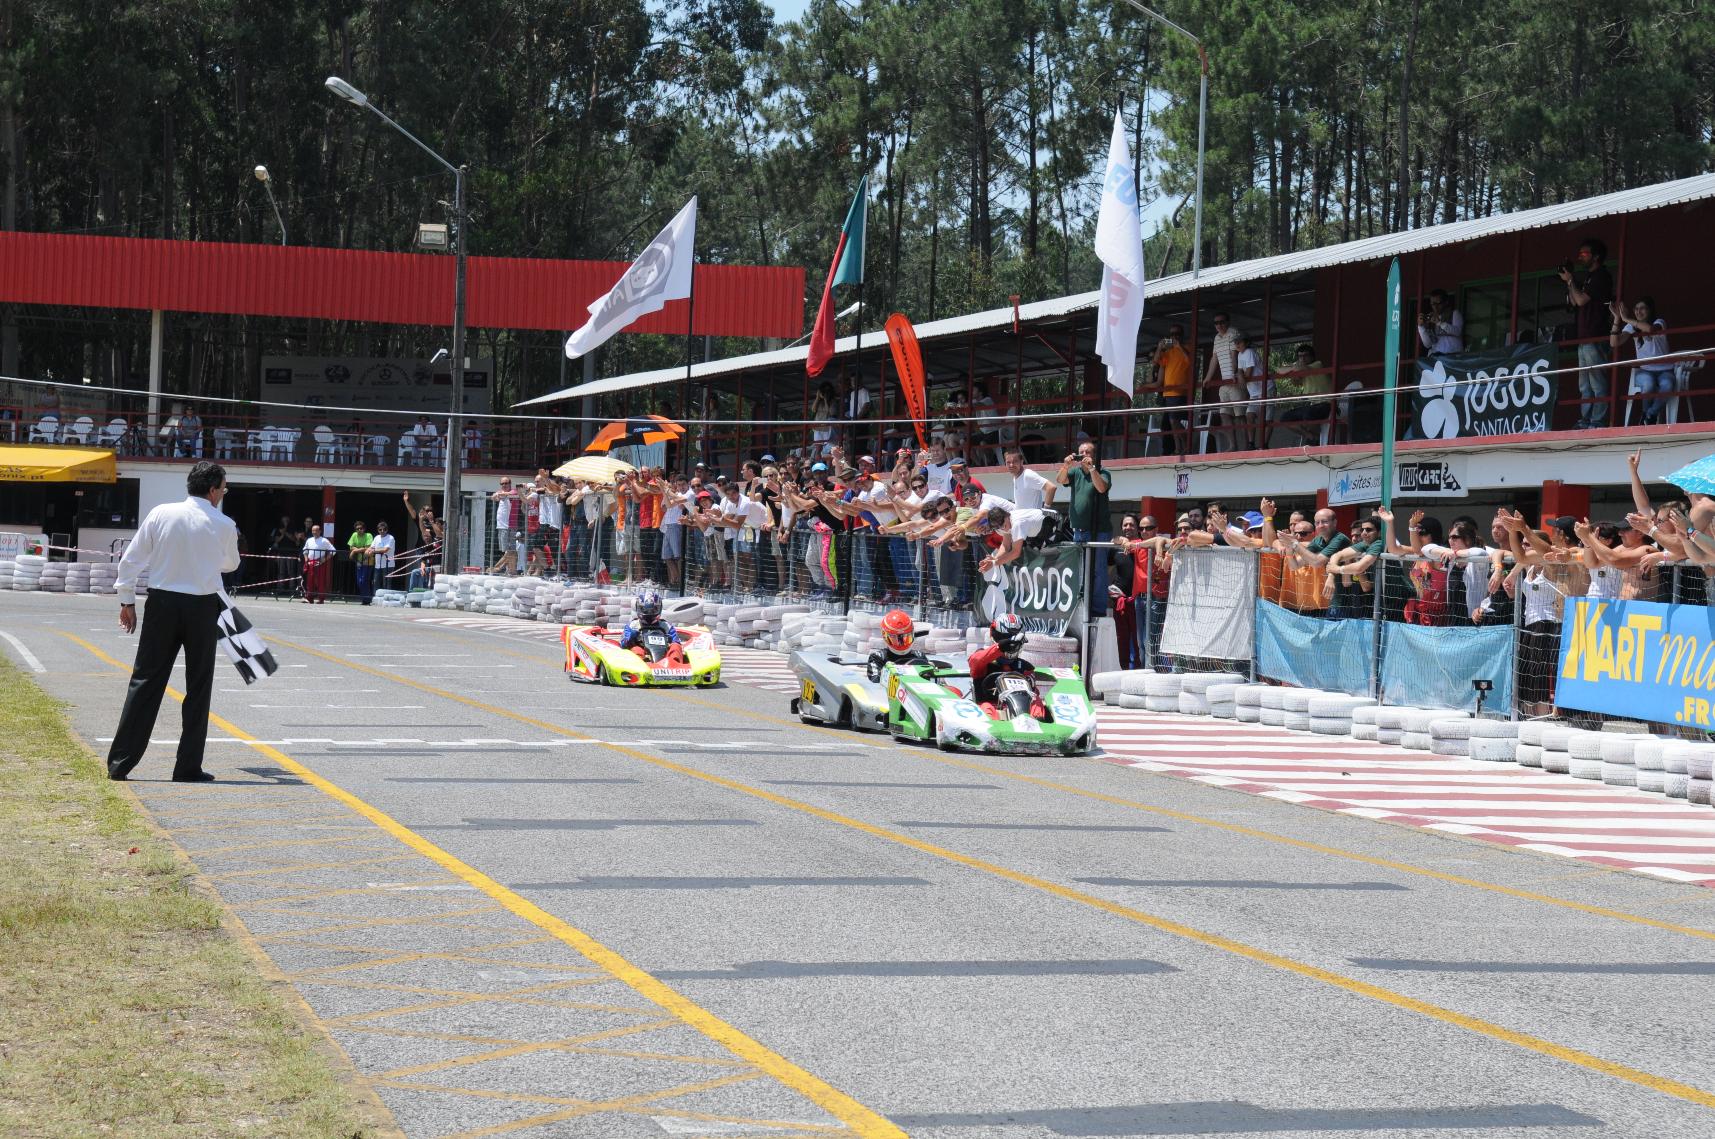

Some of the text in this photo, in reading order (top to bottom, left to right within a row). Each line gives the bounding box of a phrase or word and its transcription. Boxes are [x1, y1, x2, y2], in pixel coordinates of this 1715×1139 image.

[1463, 359, 1550, 430] JOGOS
[1011, 565, 1073, 615] JOGOS
[1562, 602, 1662, 683] KART
